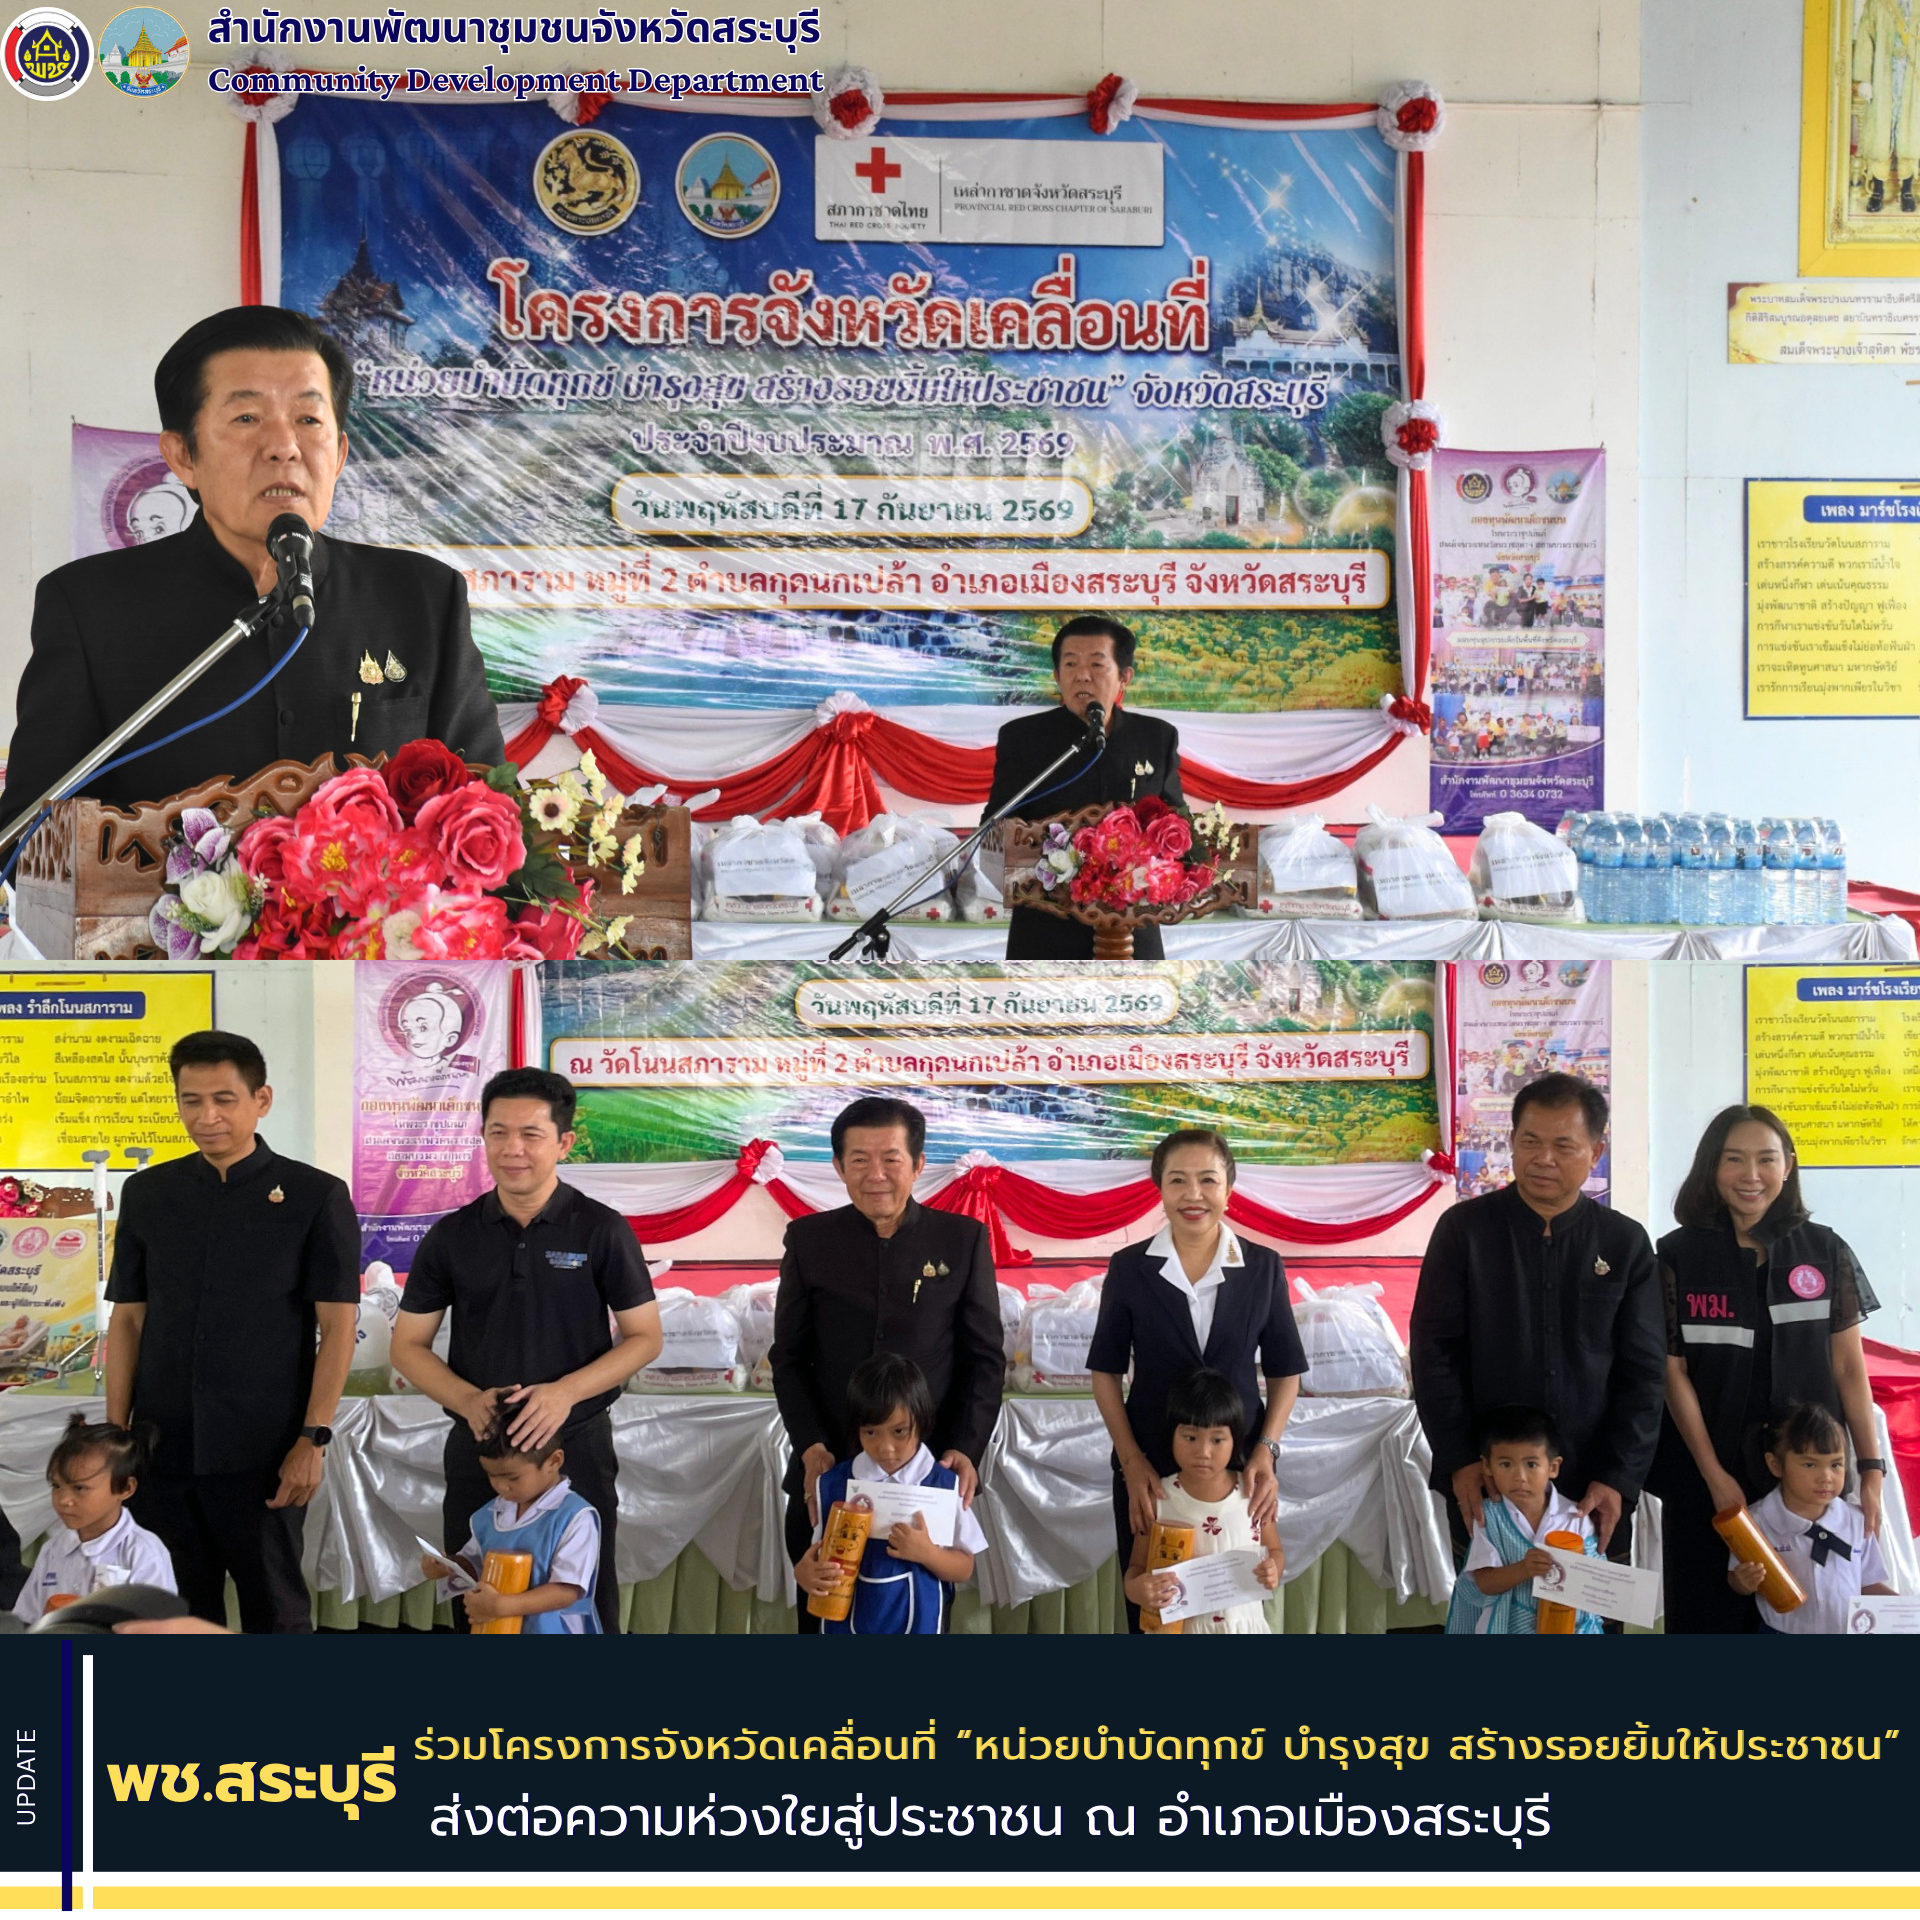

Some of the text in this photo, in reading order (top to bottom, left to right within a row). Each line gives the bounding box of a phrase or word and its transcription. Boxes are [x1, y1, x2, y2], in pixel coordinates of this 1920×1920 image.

[953, 183, 1122, 205] เหล่ากาชาดจังหวัดสระบุรี
[827, 201, 928, 218] สภากาชาดไทย
[954, 202, 1153, 214] PROVINCIAL RED CROSS CHAPTER OF SARABURI
[488, 256, 1209, 348] โครงการจังหวัดเคลื่อนที่
[621, 363, 748, 411] บำรุงสุข
[753, 364, 1126, 407] สร้างรอยยิ้มให้ประชาชน”
[1132, 371, 1329, 415] จังหวัดสระบุรี
[631, 420, 1075, 458] ประจำปีงบประมาณ พ.ศ. 2569
[632, 484, 1074, 527] วันพฤหัสบดีที่ 17 กันยายน 2569
[1821, 499, 1920, 517] เพลง มาร์ชโรงเ
[585, 551, 651, 604] หมู่ที่
[661, 568, 678, 593] 2
[687, 560, 921, 605] ตำบลกุดนกเปล้า
[931, 560, 1177, 604] อำเภอเมืองสระบุรี
[1185, 560, 1367, 606] จังหวัดสระบุรี
[1500, 790, 1507, 799] 0
[1510, 790, 1535, 799] 3634
[1537, 790, 1563, 799] 0732
[811, 985, 1163, 1021] วันพฤหัสบดีที่ 17 กันยายน 2569
[1813, 987, 1843, 997] เพลง
[27, 998, 133, 1015] รำลึกโนนสภาราม
[570, 1040, 1410, 1081] ณ วัดโนนสภาราม หมู่ที่ 2 ตำบลกุดนกเปล้า อำเภอเมืองสระบุรี จังหวัดสระบุรี
[360, 1097, 483, 1116] กองทุนพัฒนาเด็กชน
[1687, 1294, 1735, 1318] พม.
